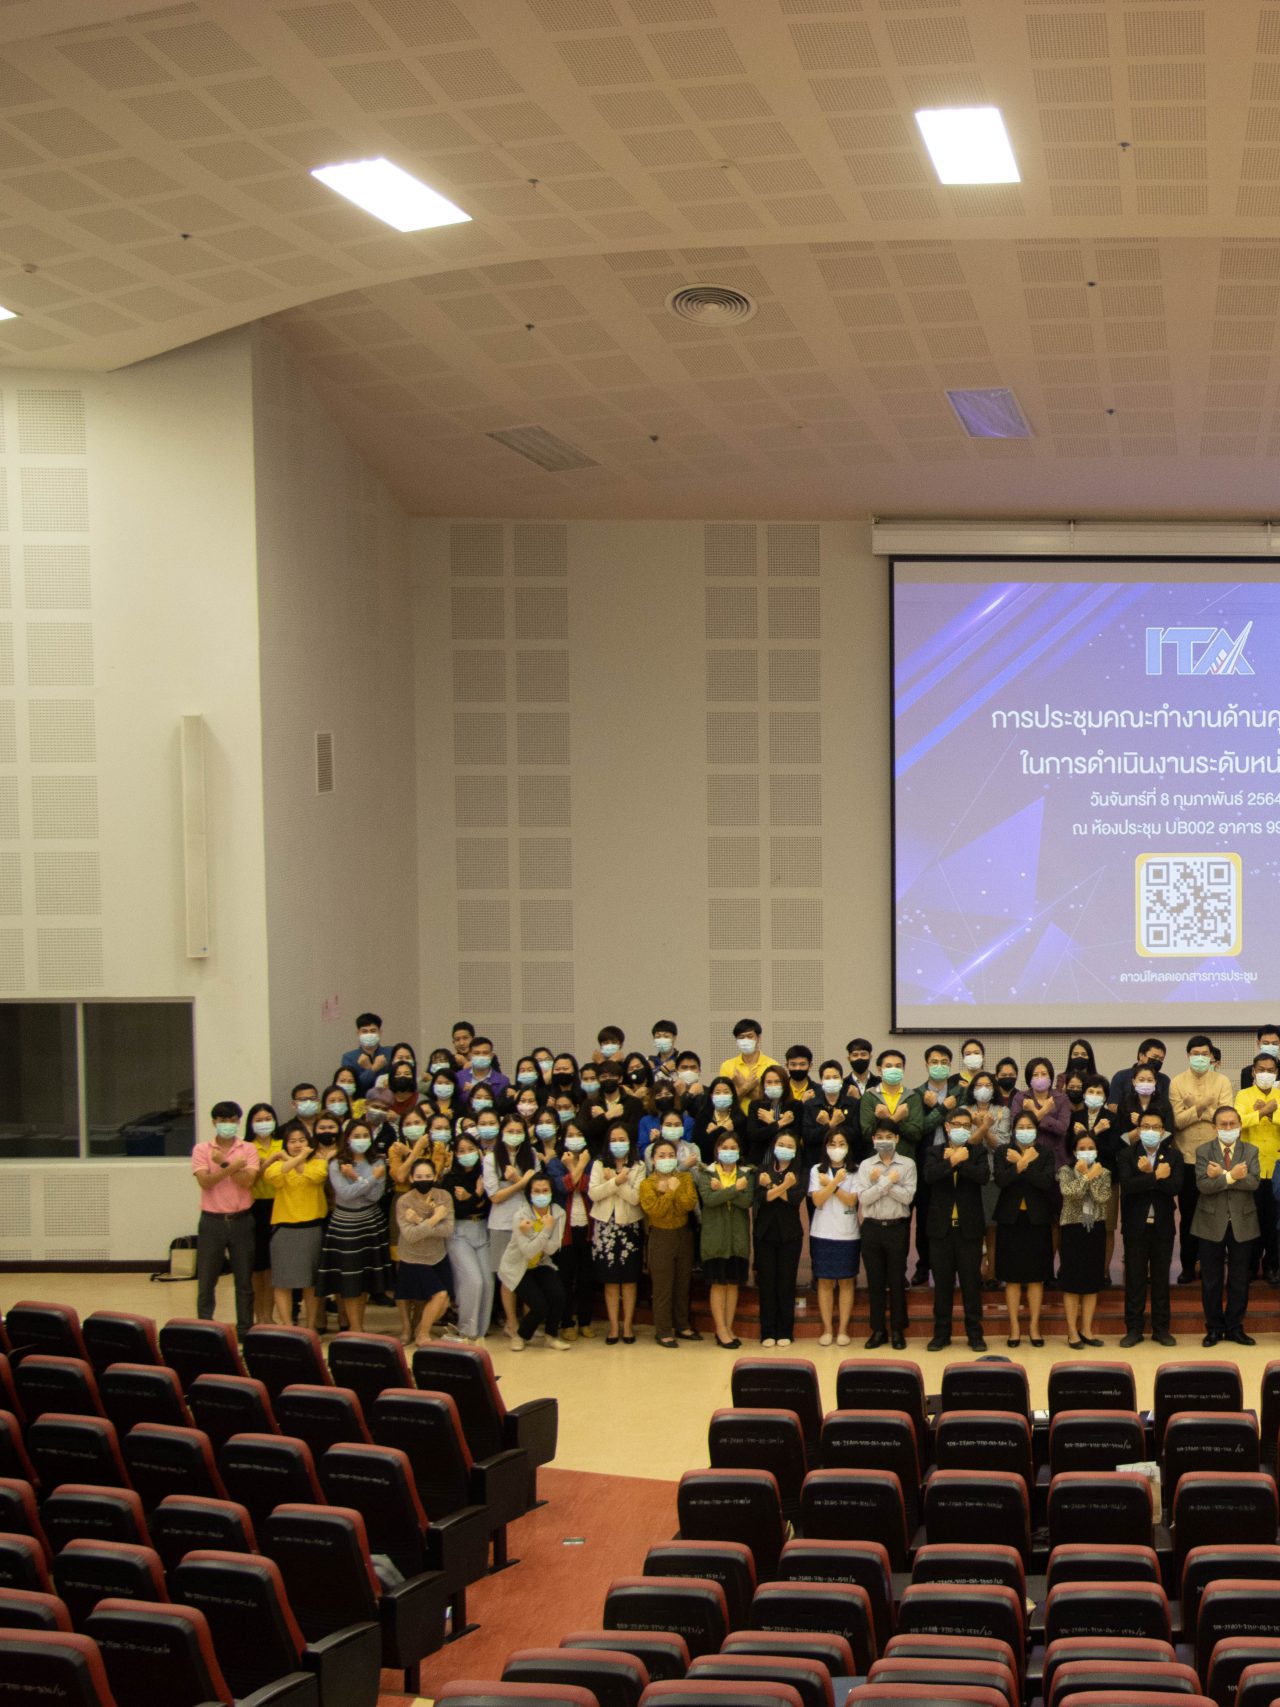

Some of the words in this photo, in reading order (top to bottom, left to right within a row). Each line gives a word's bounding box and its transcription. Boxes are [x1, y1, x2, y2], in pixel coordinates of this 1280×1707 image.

[1090, 787, 1157, 807] วันจันทร์ที่
[1160, 792, 1170, 807] 8
[1173, 789, 1244, 811] กุมภาพันธ์
[1072, 823, 1088, 836] ณ
[1092, 818, 1162, 839] ห้องประชุม
[1165, 820, 1215, 835] UB002
[1218, 822, 1263, 835] อาคาร
